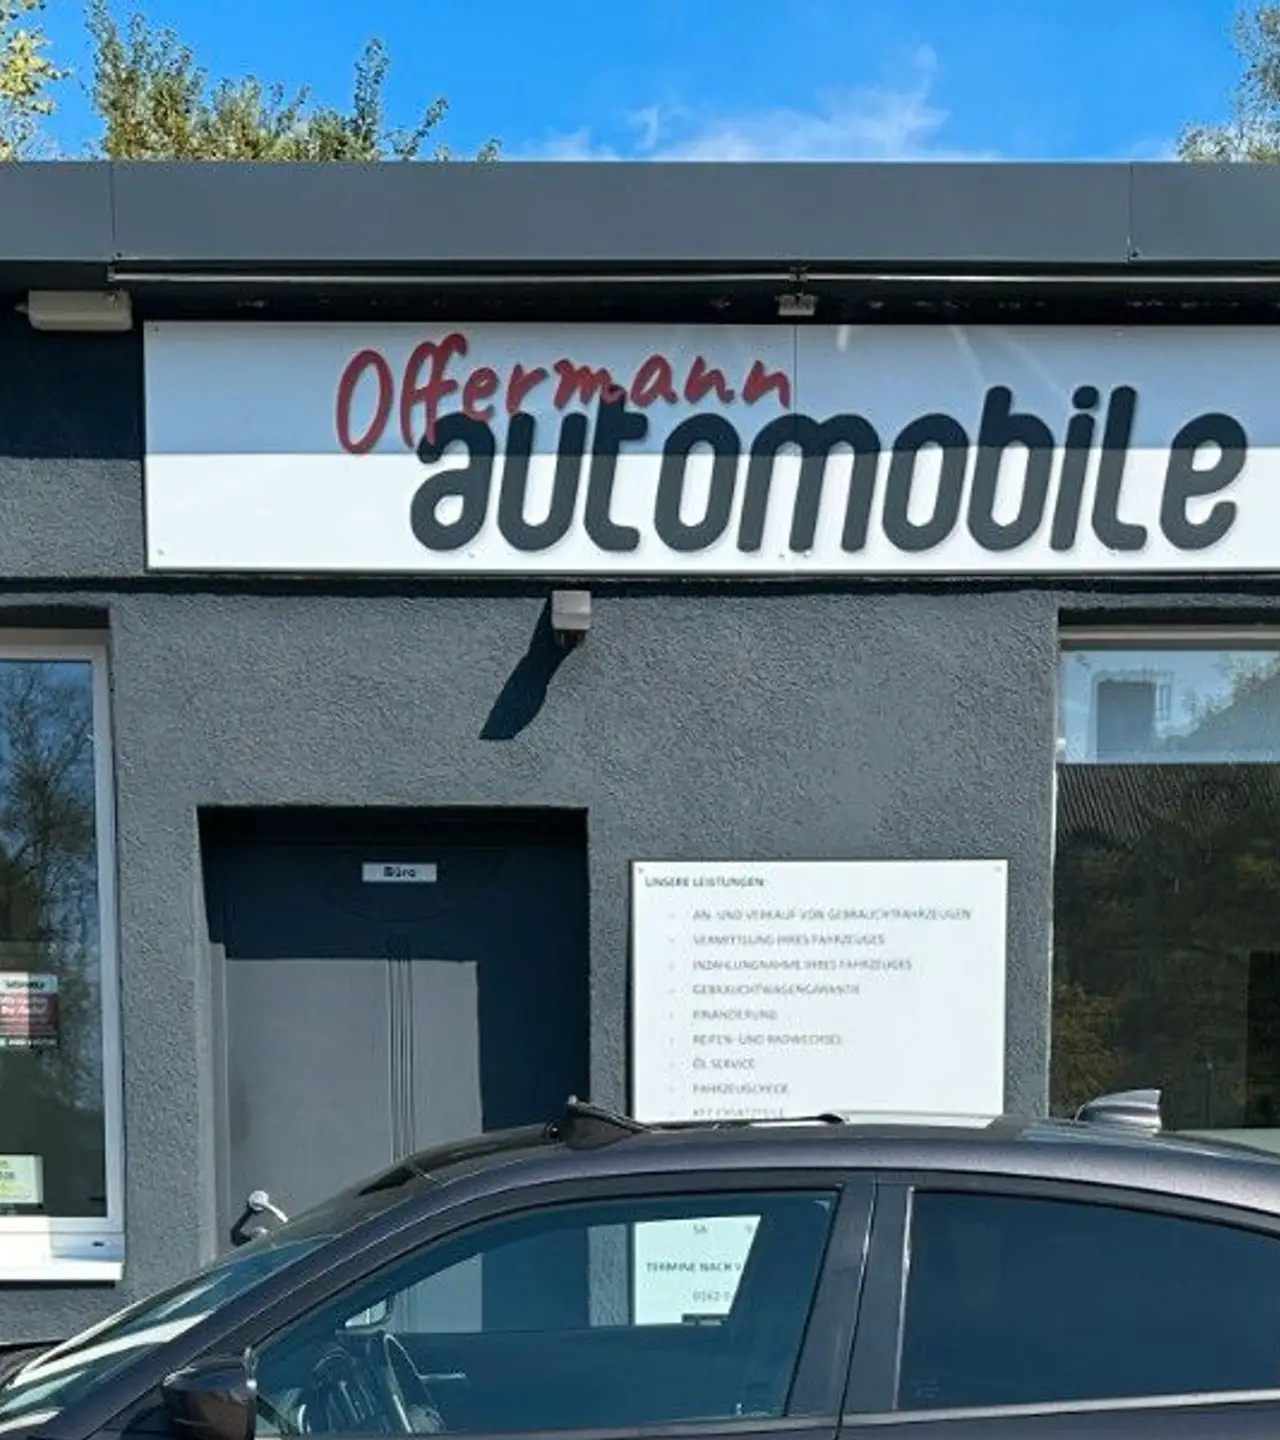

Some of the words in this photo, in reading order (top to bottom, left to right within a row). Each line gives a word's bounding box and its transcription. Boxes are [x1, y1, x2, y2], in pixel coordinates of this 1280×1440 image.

[335, 333, 790, 454] Offermann
[410, 385, 1247, 552] automobile
[645, 876, 690, 888] UNSERE
[692, 875, 765, 888] LEISTUNGEN
[717, 909, 742, 921] UND
[746, 909, 796, 921] VERKAUF
[738, 1034, 763, 1046] UND
[710, 1058, 755, 1070] SERVICE
[646, 1261, 696, 1273] TERMINE
